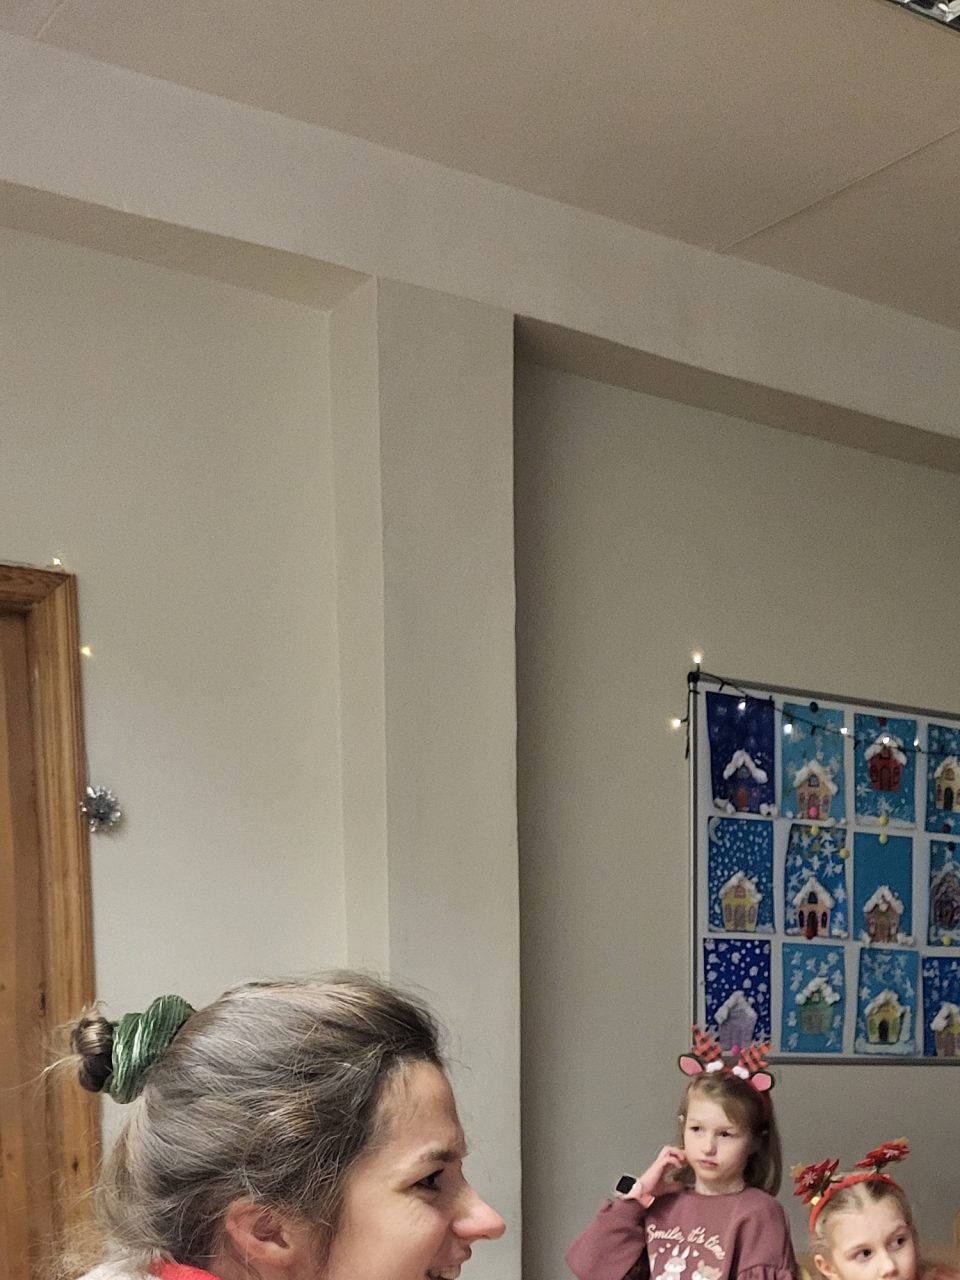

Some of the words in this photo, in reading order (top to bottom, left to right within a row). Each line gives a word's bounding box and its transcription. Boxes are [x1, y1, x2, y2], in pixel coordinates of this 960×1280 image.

[647, 1224, 685, 1244] Smile,
[687, 1226, 706, 1244] it's
[704, 1235, 726, 1260] time
